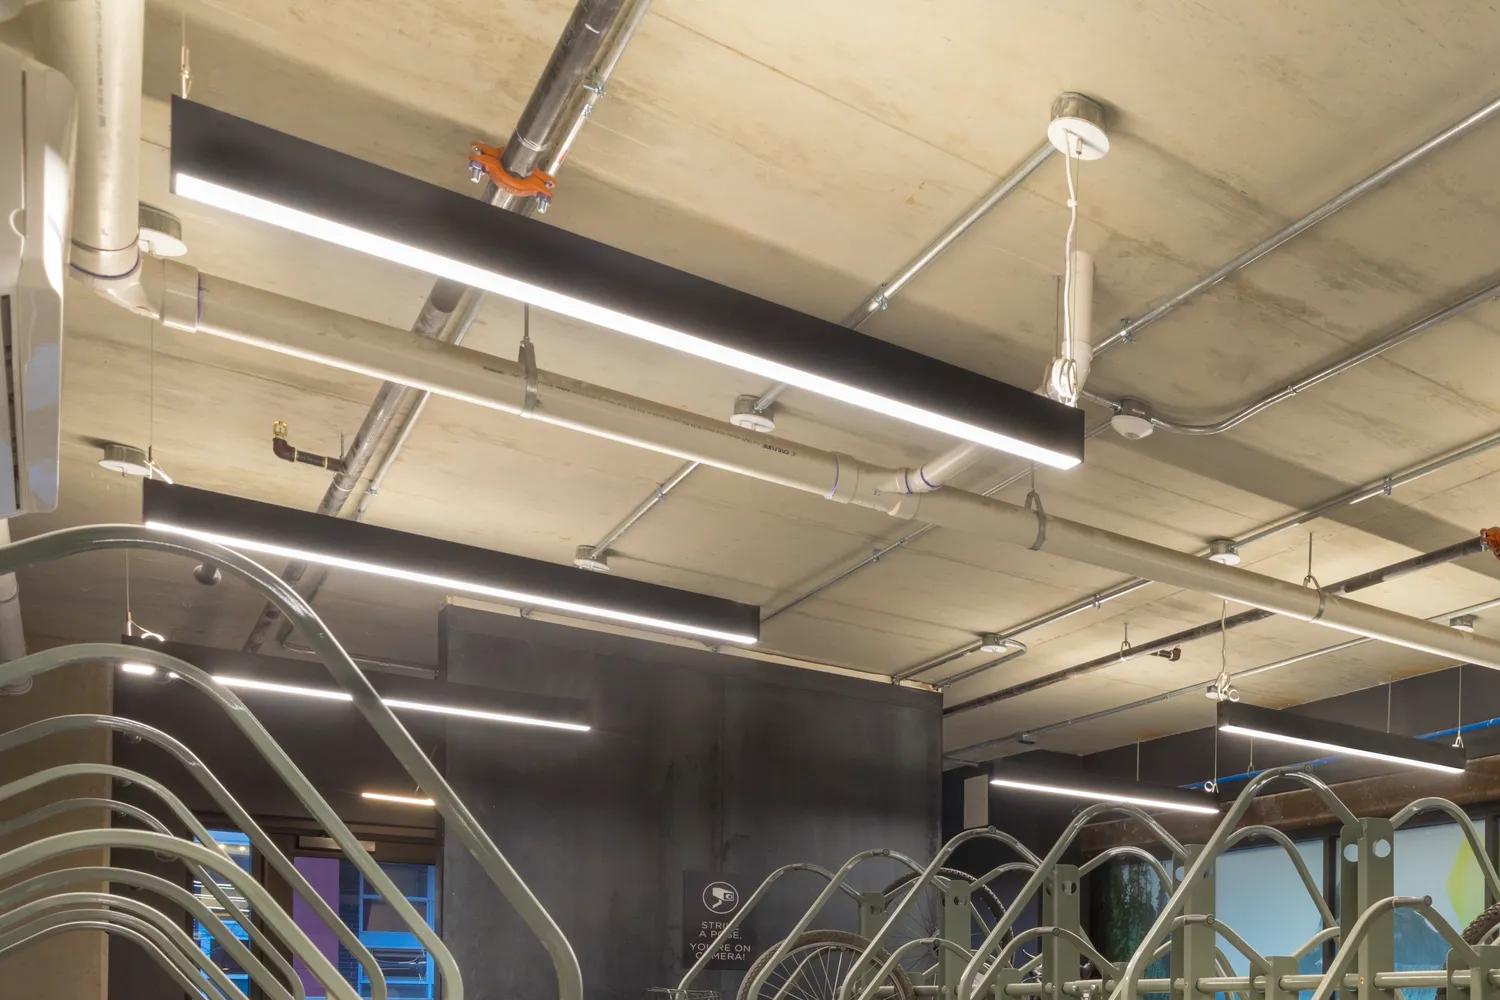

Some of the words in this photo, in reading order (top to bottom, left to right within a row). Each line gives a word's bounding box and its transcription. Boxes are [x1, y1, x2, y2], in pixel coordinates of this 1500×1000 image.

[701, 921, 740, 931] STRI
[698, 930, 707, 938] A
[734, 944, 751, 952] ON
[695, 951, 745, 961] CMERA!
